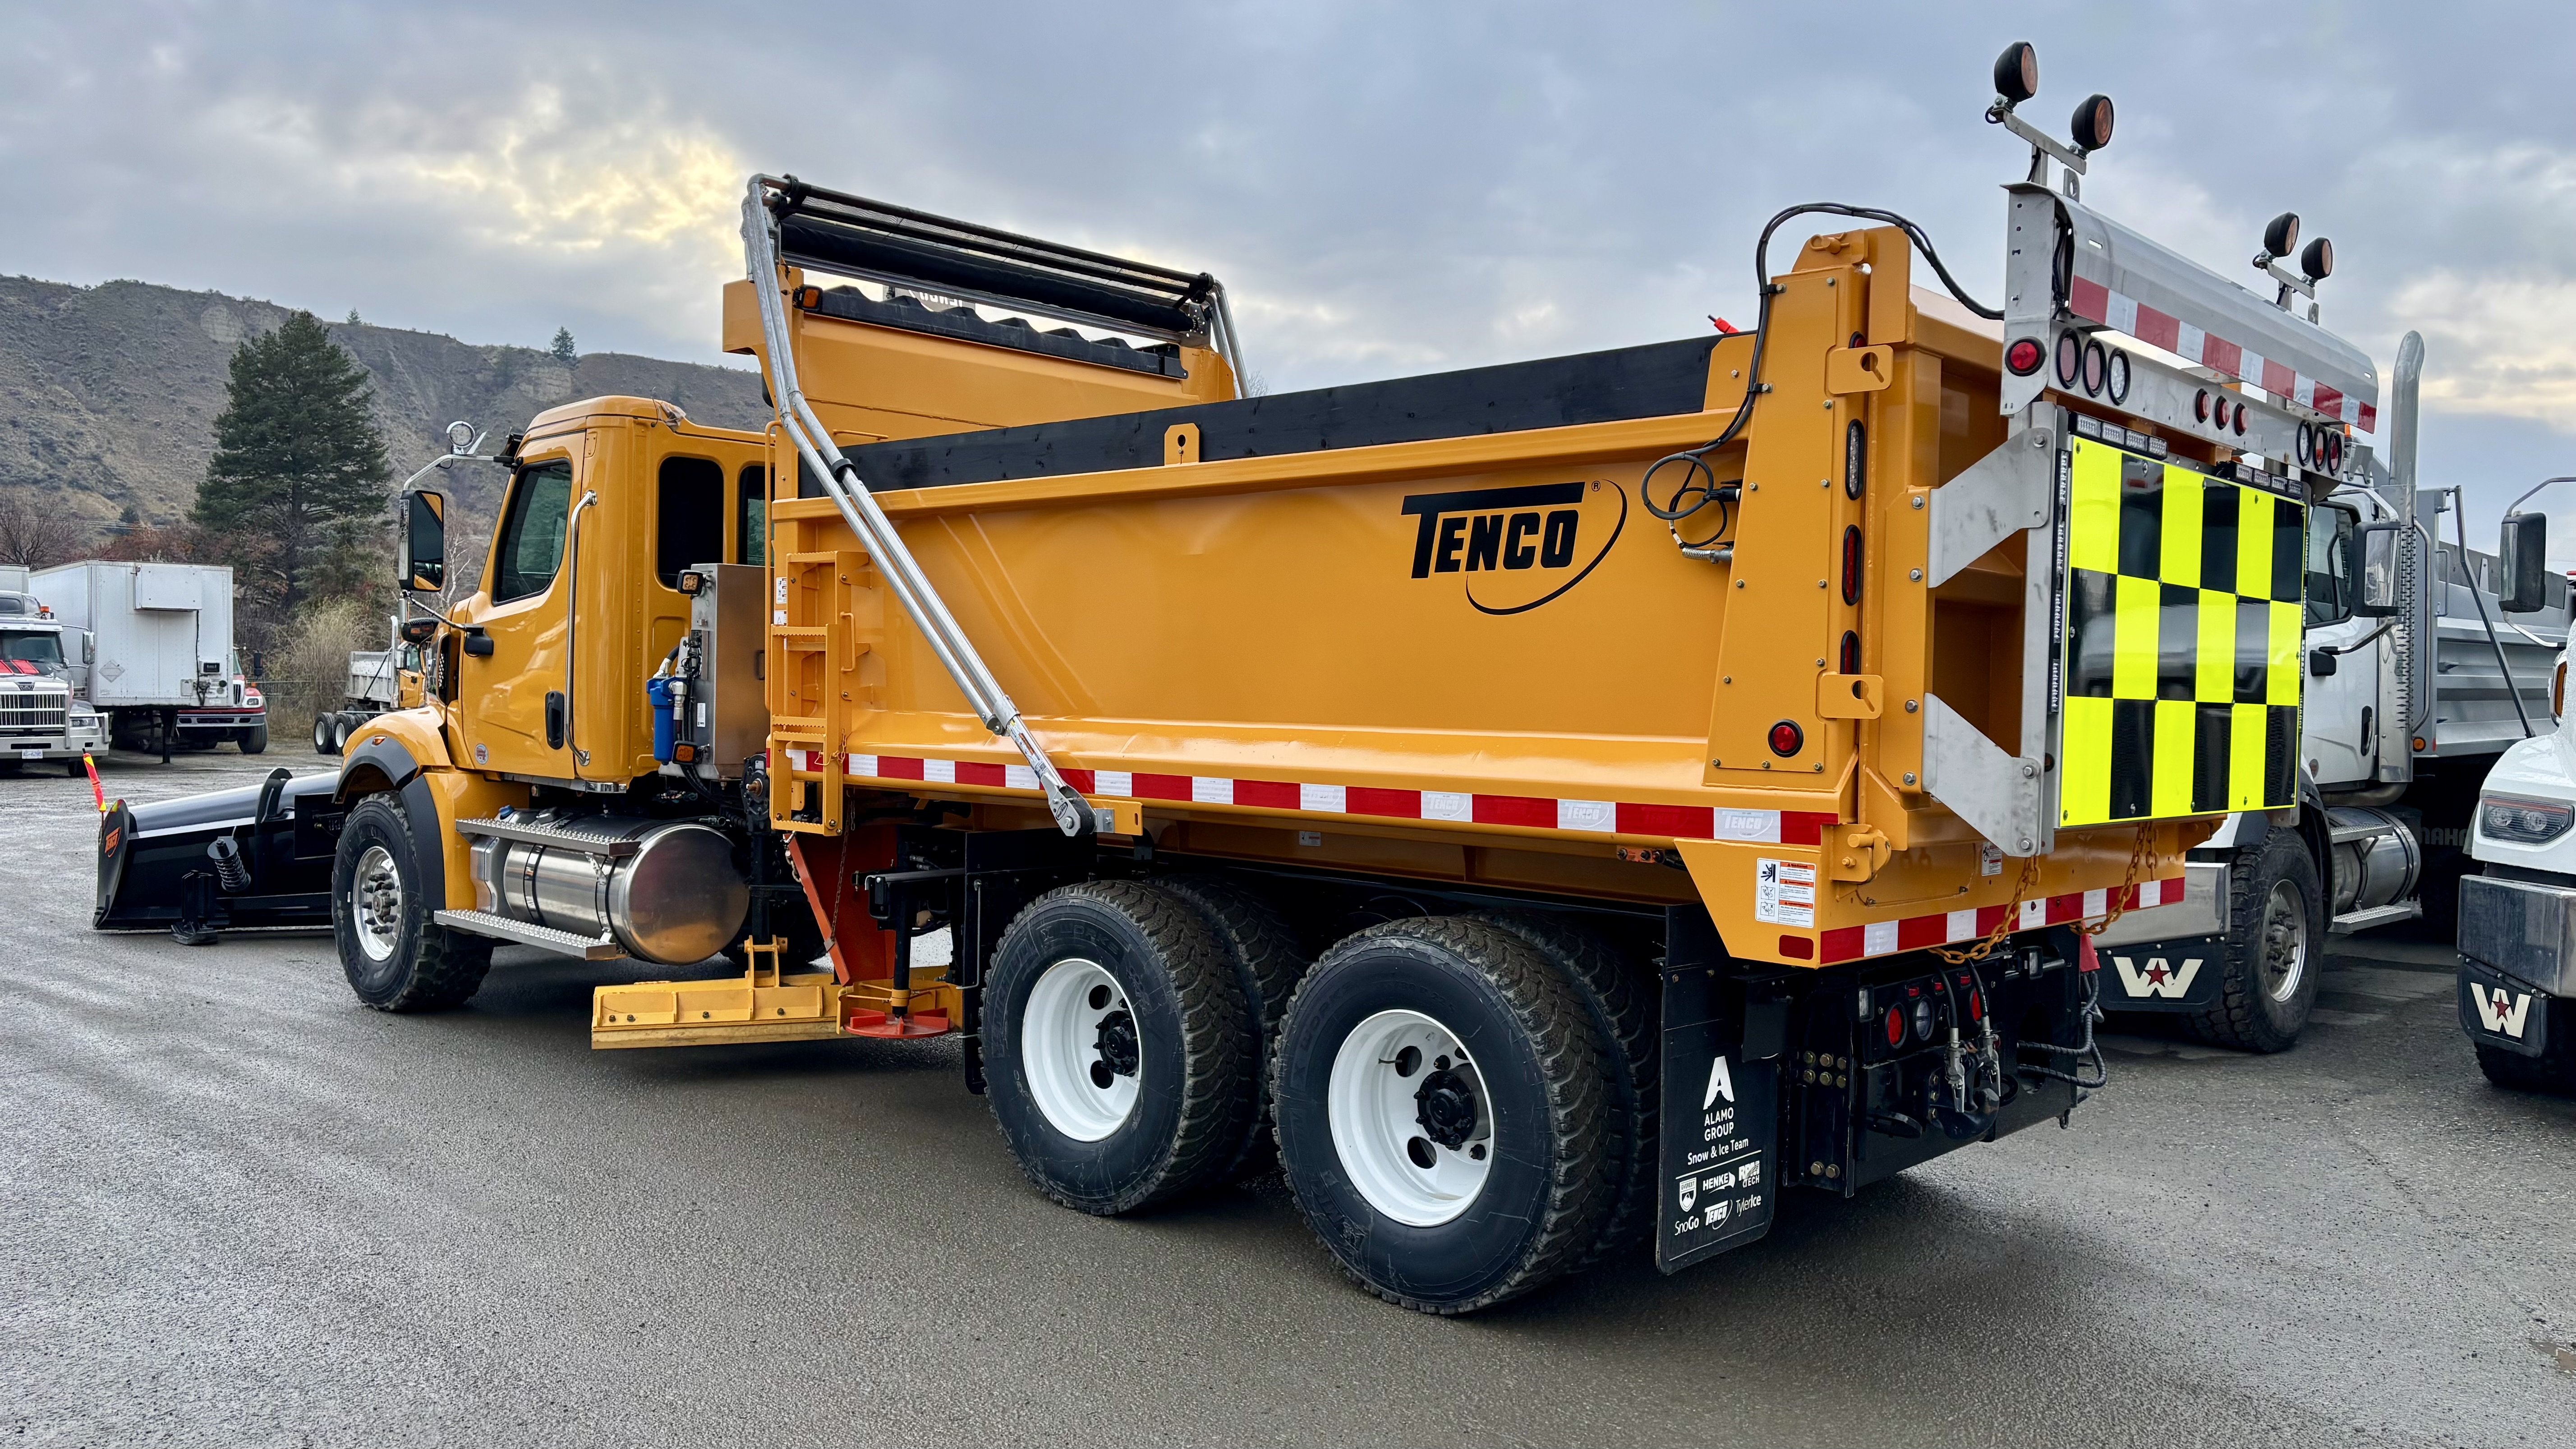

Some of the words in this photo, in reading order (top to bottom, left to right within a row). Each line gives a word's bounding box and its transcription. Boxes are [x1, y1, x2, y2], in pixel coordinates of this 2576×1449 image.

[1401, 481, 1585, 579] TENCO
[1722, 811, 1764, 830] TENCO
[1704, 1107, 1734, 1127] ALAMO
[1704, 1122, 1734, 1141] GROUP
[1688, 1152, 1709, 1165] Snow
[1711, 1145, 1717, 1159] &
[1719, 1144, 1729, 1155] Ice
[1730, 1138, 1748, 1151] Team
[1702, 1173, 1729, 1191] HENKE
[1704, 1200, 1728, 1226] TENCO
[1736, 1194, 1762, 1217] TylerIce
[1674, 1215, 1699, 1236] SnoGo
